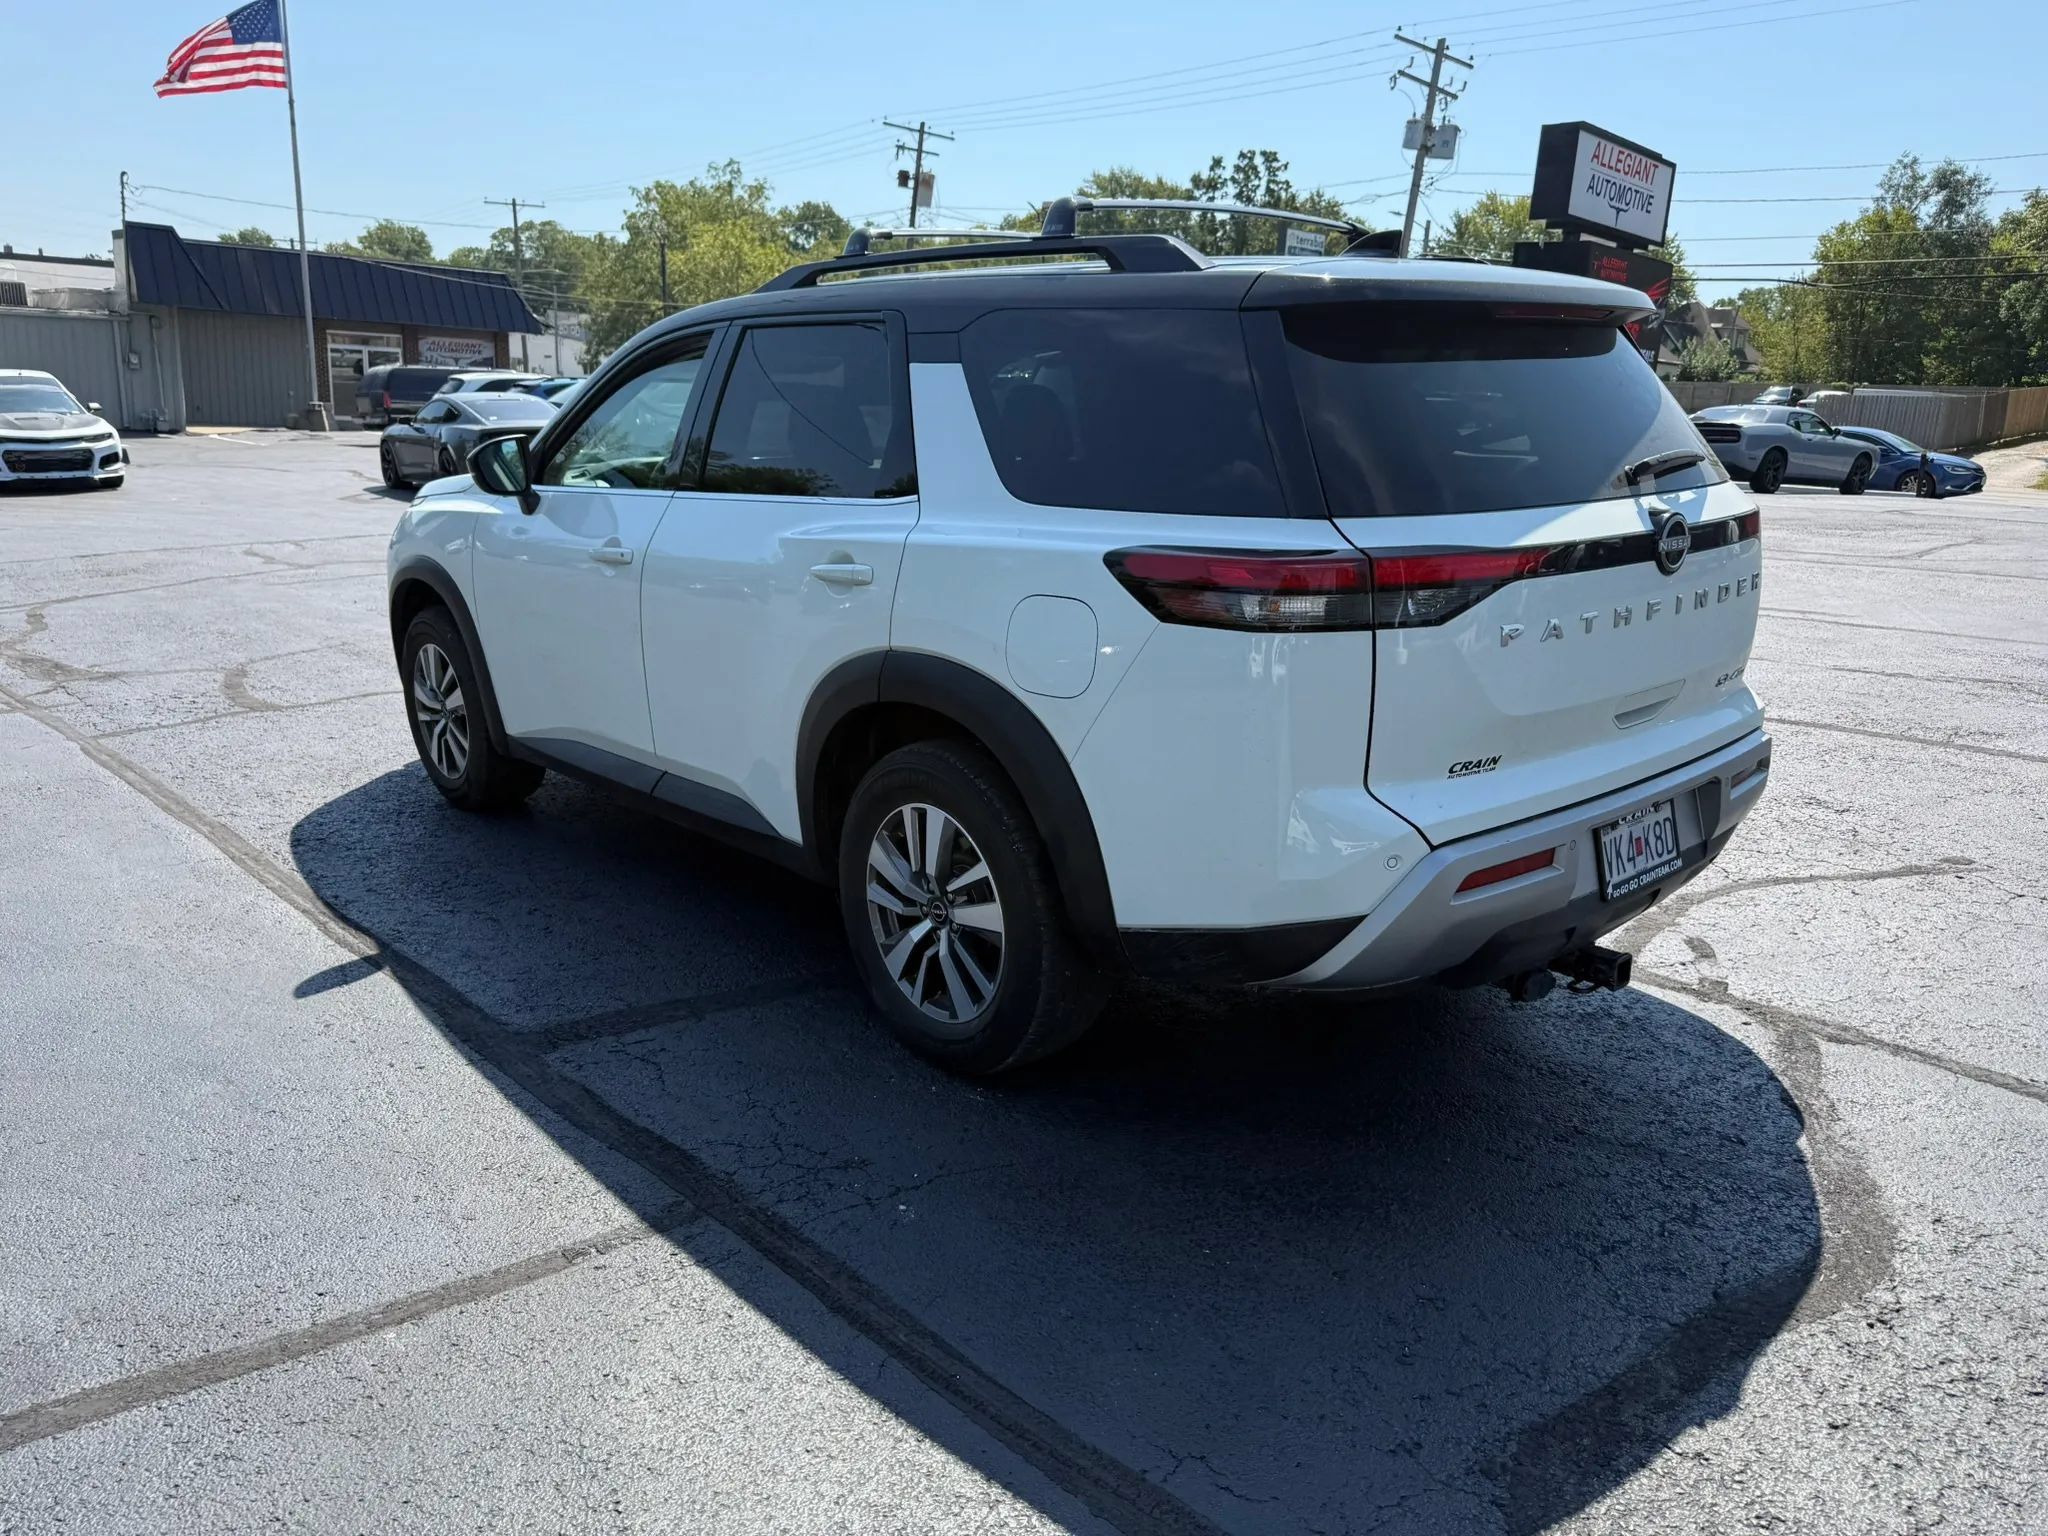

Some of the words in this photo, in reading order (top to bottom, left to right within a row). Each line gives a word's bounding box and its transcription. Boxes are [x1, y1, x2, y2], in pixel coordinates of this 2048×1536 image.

[1591, 141, 1659, 186] ALLEGIANT
[1586, 174, 1655, 214] AUTOMOTIVE
[1500, 571, 1760, 647] PATHFINDER
[1447, 770, 1481, 779] AUTOMOTIVE
[1448, 754, 1503, 774] CRAIN
[1603, 829, 1637, 878] VK4
[1643, 817, 1675, 864] K8D
[1620, 884, 1628, 894] GO
[1629, 878, 1638, 890] GO
[1639, 857, 1683, 886] CRAINTEAM.COM
